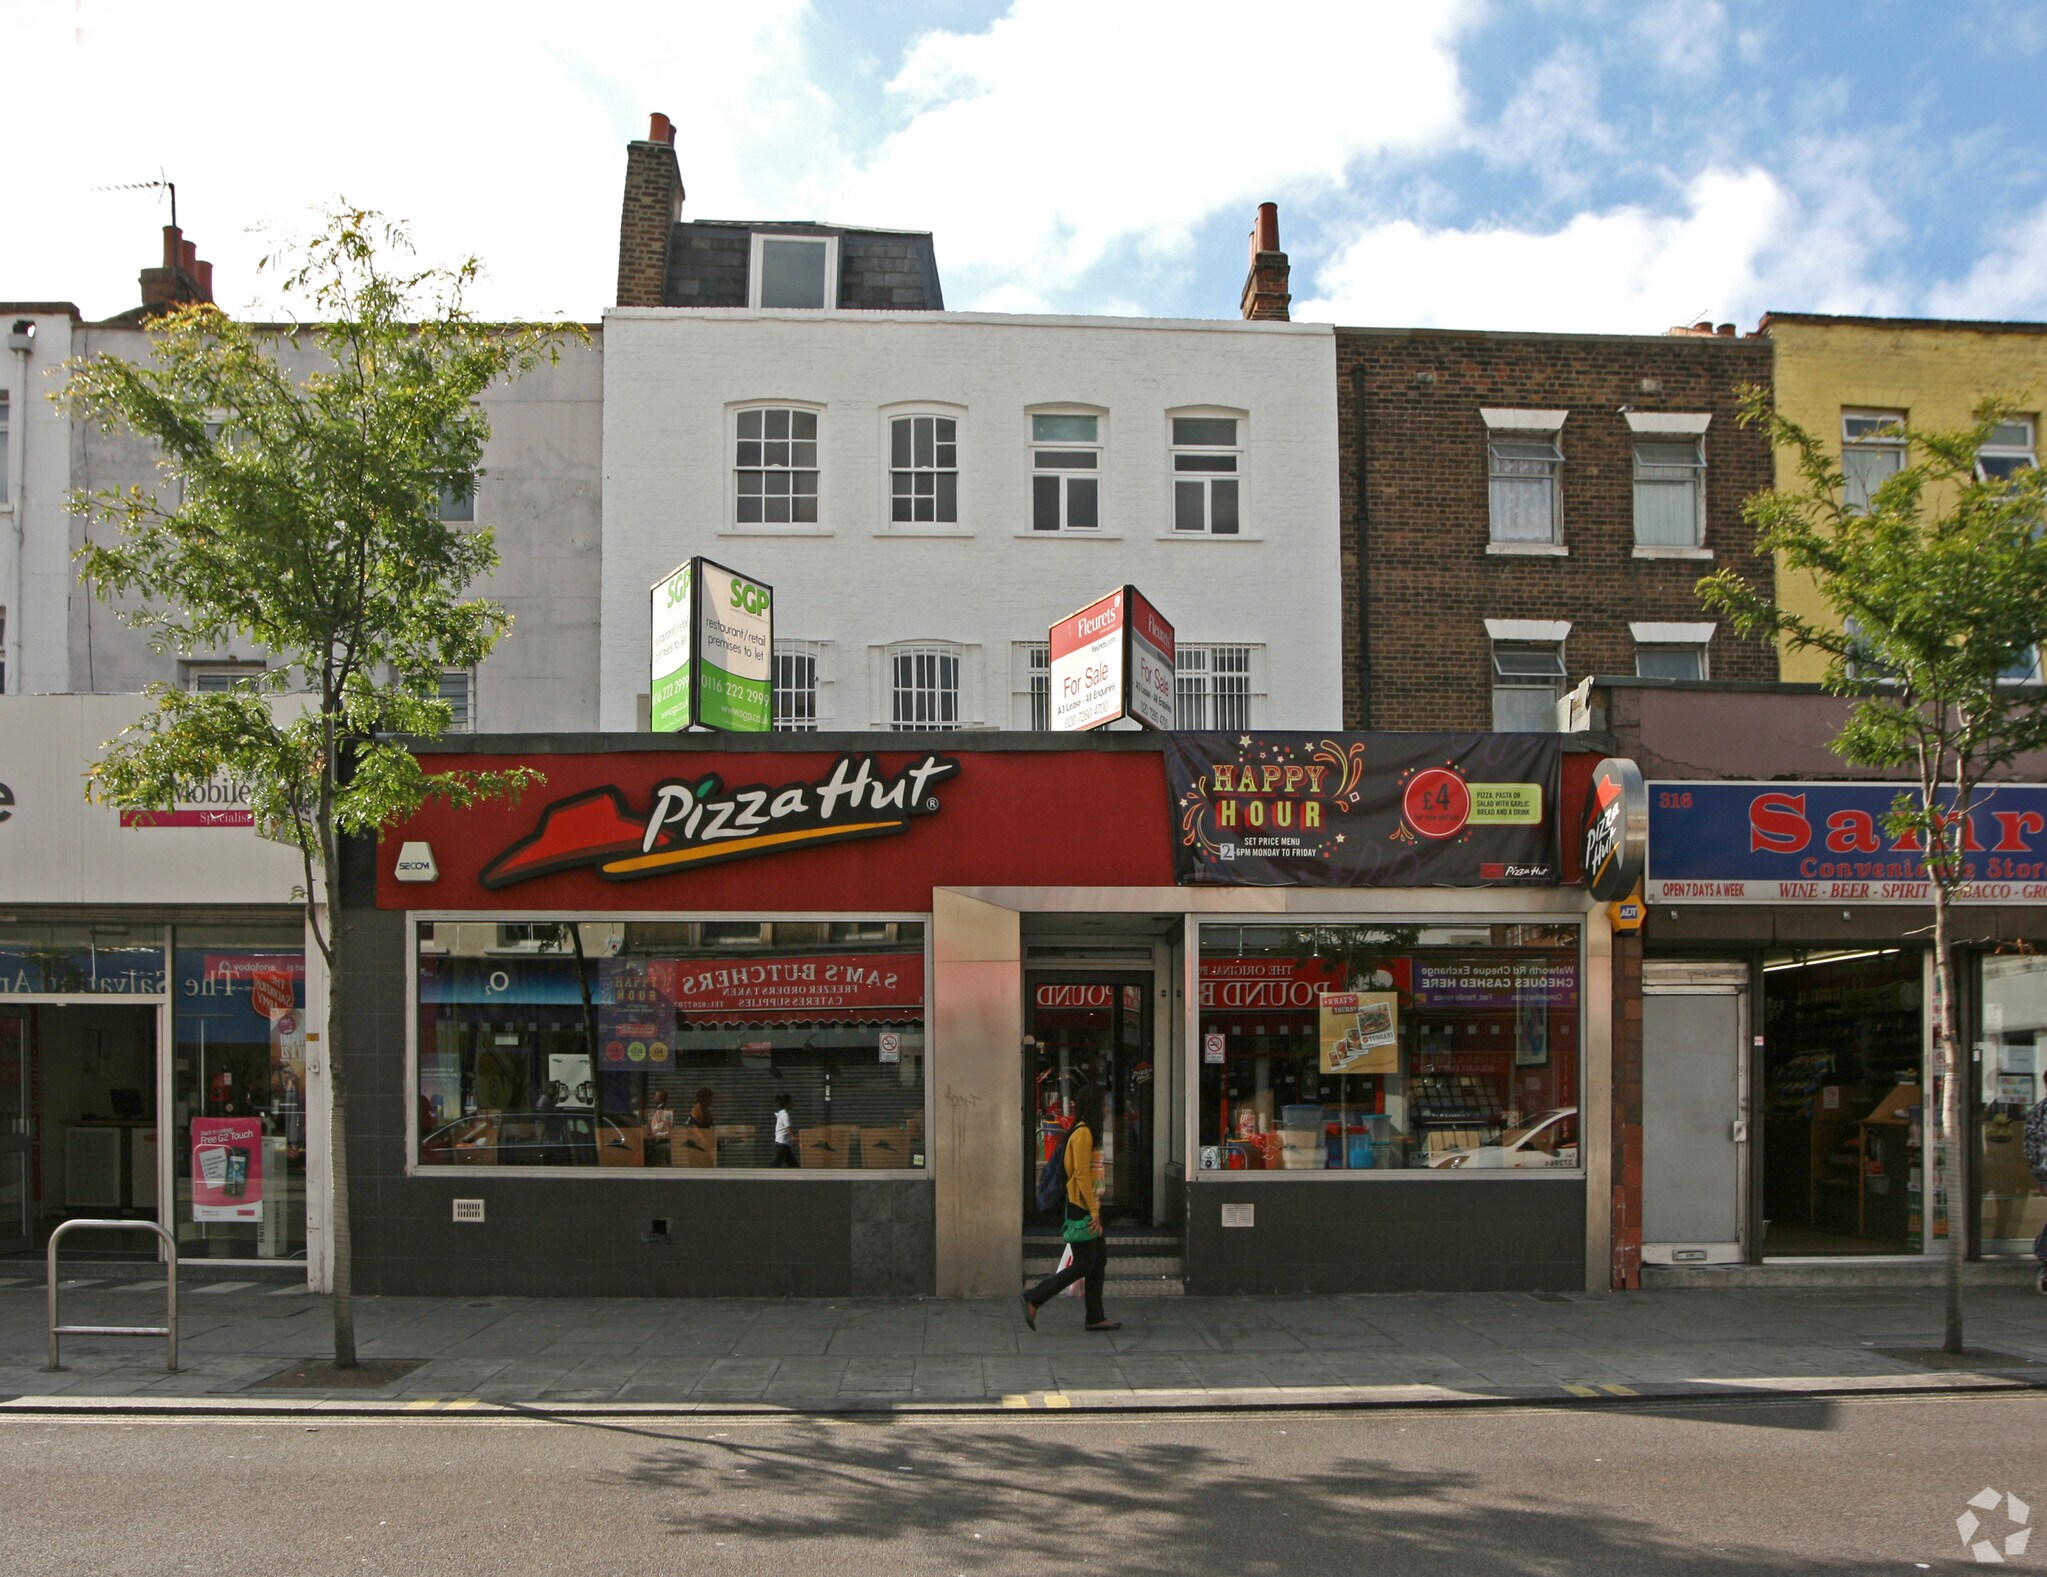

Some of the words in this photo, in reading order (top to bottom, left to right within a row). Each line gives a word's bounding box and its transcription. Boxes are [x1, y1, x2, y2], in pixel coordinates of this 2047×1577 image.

[667, 568, 691, 608] SGP
[730, 578, 770, 617] SGP
[705, 616, 766, 646] restaurant/retail
[1078, 607, 1116, 639] Fleurets
[708, 635, 741, 655] premises
[743, 645, 752, 658] to
[754, 647, 764, 662] let
[1064, 676, 1081, 699] For
[1085, 662, 1109, 689] Sale
[1140, 656, 1152, 684] For
[1155, 668, 1170, 697] Sale
[662, 682, 673, 700] 222
[674, 675, 690, 695] 2999
[701, 675, 722, 693] 0116
[725, 682, 743, 700] 222
[747, 688, 770, 707] 2999
[1212, 765, 1326, 793] HAPPY
[171, 776, 251, 805] Mobile
[1422, 783, 1449, 811] £4
[1476, 791, 1494, 799] PIZZA,
[1495, 791, 1512, 799] PASTA
[1513, 791, 1521, 799] OR
[1659, 792, 1693, 809] 316
[642, 779, 809, 853] Pizza
[816, 756, 953, 819] Hut
[1476, 800, 1494, 808] SALAD
[1495, 800, 1510, 808] WITH
[1510, 800, 1530, 808] GARLIC
[1476, 808, 1495, 816] BREAD
[1496, 808, 1508, 816] AND
[1508, 808, 1512, 816] A
[1513, 808, 1530, 816] DRINK
[200, 811, 251, 825] Specialist
[1218, 800, 1324, 829] HOUR
[1244, 837, 1257, 846] SET
[1258, 837, 1280, 846] PRICE
[1281, 837, 1301, 846] MENU
[1585, 801, 1620, 869] Pizza
[1252, 848, 1281, 857] MONDAY
[1282, 848, 1291, 857] TO
[1291, 848, 1317, 857] FRIDAY
[1592, 826, 1617, 875] Hut
[398, 861, 430, 870] SECOM
[1504, 866, 1530, 877] Pizza
[1530, 866, 1549, 877] Hut
[1800, 856, 1976, 878] Conveniee
[1986, 857, 2047, 879] Stor
[1663, 883, 1685, 897] OPEN
[1686, 883, 1691, 897] 7
[1692, 883, 1714, 897] DAYS
[1715, 883, 1722, 897] A
[1723, 883, 1744, 897] WEEK
[1779, 882, 1818, 899] WINE
[1830, 882, 1869, 899] BEER
[1881, 882, 1930, 899] SPIRIT
[1950, 884, 2011, 899] BACCO
[1620, 907, 1638, 917] ADT
[233, 962, 275, 972] vodafone
[615, 975, 657, 988] HAPPY
[616, 989, 656, 1001] HOUR
[1327, 995, 1354, 1005] WHAT'S
[200, 1135, 217, 1145] Free
[218, 1133, 229, 1143] G2
[231, 1129, 254, 1141] Touch
